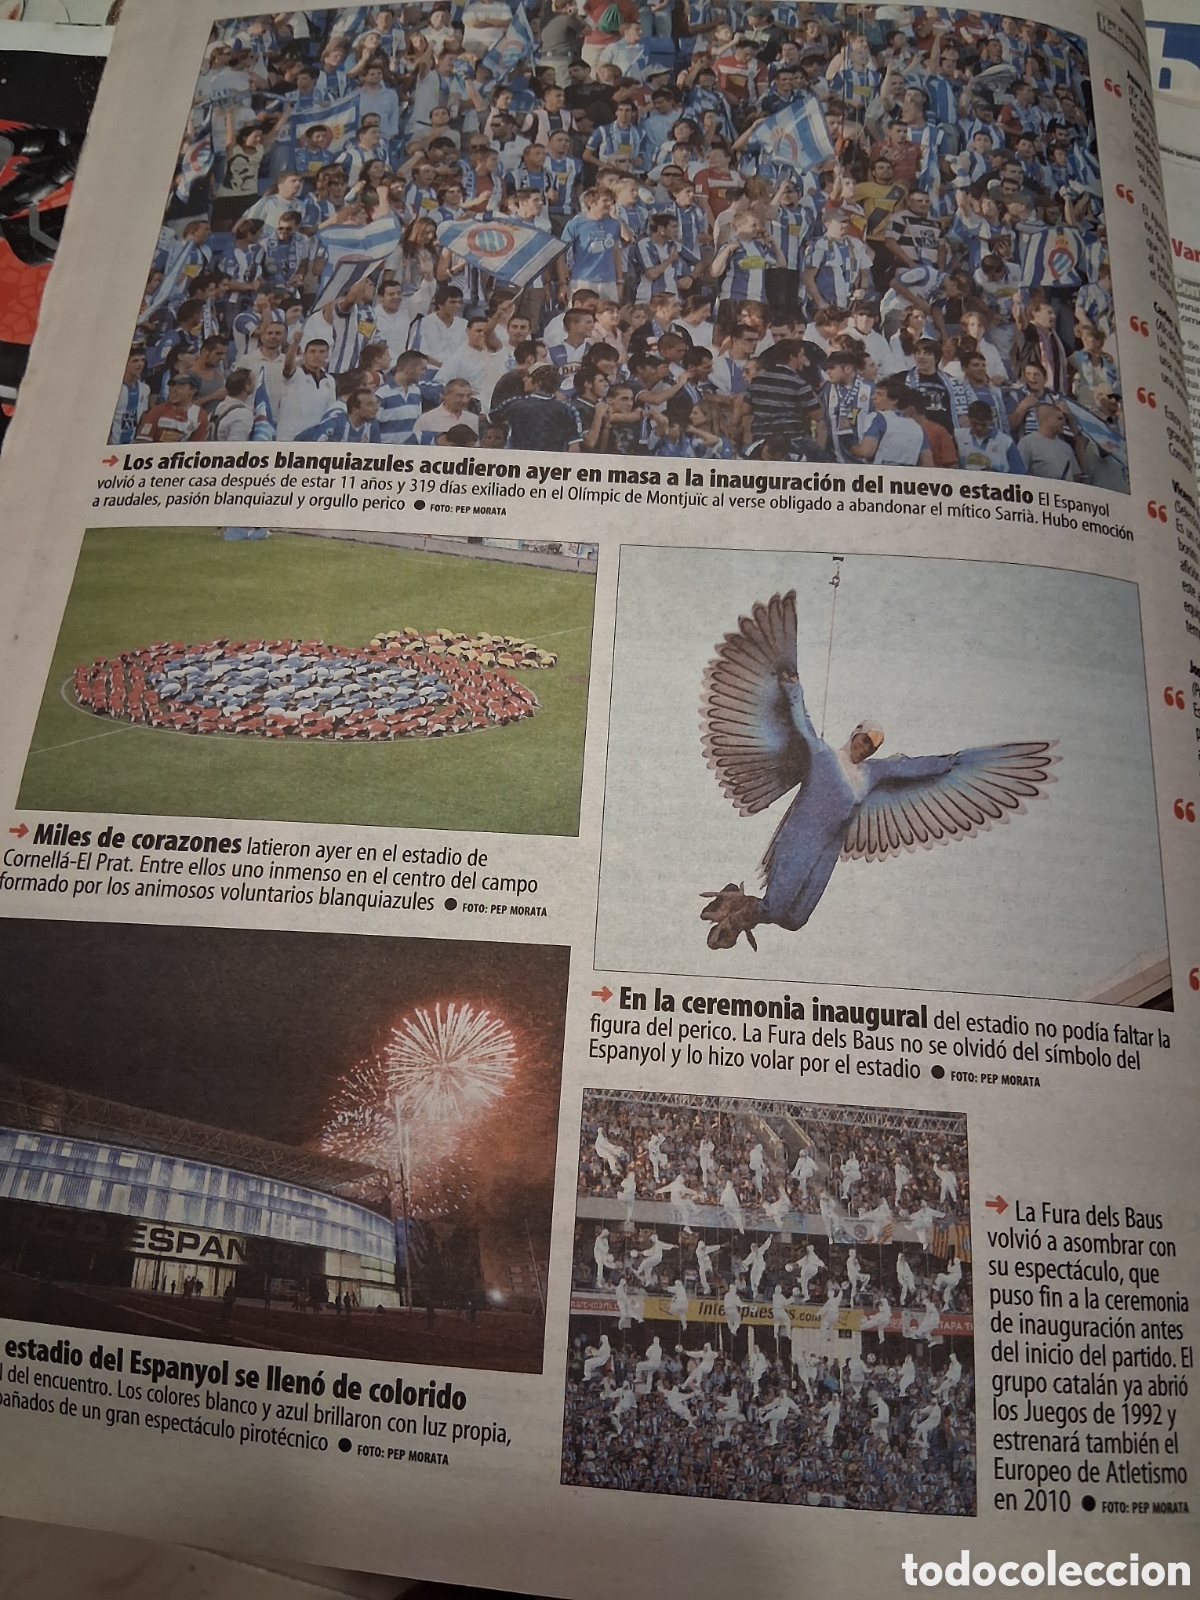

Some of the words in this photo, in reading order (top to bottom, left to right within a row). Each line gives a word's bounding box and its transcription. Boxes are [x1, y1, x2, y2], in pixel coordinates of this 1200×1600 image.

[123, 454, 153, 470] Los
[158, 451, 269, 469] aficionados
[274, 452, 414, 474] blanquiazules
[420, 457, 520, 478] acudieron
[526, 466, 572, 484] ayer
[577, 469, 601, 482] en
[608, 470, 660, 485] masa
[667, 472, 679, 486] a
[685, 468, 703, 487] la
[710, 468, 845, 494] inauguración
[852, 475, 883, 493] del
[890, 481, 953, 497] nuevo
[960, 484, 1033, 504] estadio
[1039, 492, 1049, 506] El
[1054, 494, 1109, 517] Espanyol
[98, 475, 135, 489] volvió
[138, 478, 146, 488] a
[150, 476, 185, 487] tener
[189, 477, 217, 487] casa
[221, 473, 276, 490] después
[281, 474, 297, 487] de
[302, 476, 336, 488] estar
[341, 476, 355, 489] 11
[361, 477, 393, 490] años
[397, 481, 406, 494] y
[409, 479, 435, 493] 319
[440, 480, 467, 494] días
[472, 482, 525, 497] exiliado
[530, 488, 546, 498] en
[552, 486, 563, 499] el
[568, 486, 621, 505] Olímpic
[625, 489, 642, 503] de
[647, 490, 708, 509] Montjuïc
[712, 493, 724, 507] al
[729, 497, 765, 508] verse
[770, 495, 831, 513] obligado
[837, 501, 844, 511] a
[849, 498, 926, 515] abandonar
[931, 502, 942, 516] el
[948, 503, 991, 519] mítico
[1043, 511, 1078, 529] Hubo
[1082, 521, 1133, 541] emoción
[33, 823, 92, 847] Miles
[97, 826, 125, 848] de
[132, 834, 242, 854] corazones
[247, 837, 310, 857] latieron
[316, 845, 352, 863] ayer
[357, 847, 376, 861] en
[383, 844, 397, 862] el
[402, 847, 462, 865] estadio
[467, 848, 487, 867] de
[0, 871, 68, 892] formado
[73, 880, 103, 898] por
[107, 876, 130, 895] los
[135, 879, 215, 899] animosos
[221, 882, 314, 904] voluntarios
[319, 886, 434, 912] blanquiazules
[463, 903, 488, 913] FOTO:
[490, 904, 507, 914] PEP
[510, 906, 547, 916] MORATA
[4, 849, 92, 870] Cornellá-El
[96, 853, 133, 872] Prat.
[140, 855, 183, 874] Entre
[189, 857, 226, 876] ellos
[232, 864, 264, 878] uno
[269, 861, 341, 882] inmenso
[347, 870, 367, 883] en
[373, 867, 388, 884] el
[393, 871, 445, 887] centro
[451, 870, 476, 889] del
[482, 877, 537, 897] campo
[620, 986, 646, 1010] En
[654, 988, 675, 1012] la
[682, 995, 804, 1020] ceremonia
[812, 996, 927, 1031] inaugural
[934, 1010, 960, 1031] del
[966, 1015, 1029, 1035] estadio
[1035, 1023, 1057, 1038] no
[1063, 1021, 1109, 1043] podía
[1113, 1023, 1154, 1046] faltar
[1158, 1028, 1170, 1048] la
[590, 1013, 640, 1038] figura
[647, 1017, 672, 1037] del
[679, 1020, 736, 1043] perico.
[743, 1023, 761, 1042] La
[769, 1024, 805, 1045] Fura
[812, 1027, 847, 1048] dels
[853, 1030, 894, 1051] Baus
[901, 1038, 923, 1053] no
[929, 1040, 947, 1055] se
[953, 1037, 1006, 1059] olvidó
[1013, 1041, 1039, 1061] del
[1045, 1044, 1111, 1067] símbolo
[1117, 1049, 1140, 1070] del
[1016, 1200, 1035, 1222] La
[1042, 1202, 1080, 1225] Fura
[1086, 1205, 1120, 1227] dels
[1125, 1207, 1163, 1229] Baus
[989, 1260, 1008, 1276] su
[1015, 1259, 1124, 1286] espectáculo,
[1129, 1267, 1159, 1289] que
[991, 1310, 1013, 1333] de
[1019, 1312, 1135, 1342] inauguración
[1141, 1321, 1183, 1340] antes
[5, 1339, 83, 1366] estadio
[89, 1345, 123, 1372] del
[130, 1350, 229, 1389] Espanyol
[235, 1369, 259, 1389] se
[266, 1365, 325, 1396] llenó
[333, 1372, 362, 1400] de
[369, 1378, 466, 1410] colorido
[8, 1365, 29, 1385] del
[34, 1373, 112, 1396] encuentro.
[118, 1379, 142, 1400] Los
[147, 1385, 200, 1408] colores
[206, 1390, 257, 1415] blanco
[262, 1403, 271, 1422] y
[276, 1402, 308, 1422] azul
[314, 1403, 381, 1430] brillaron
[387, 1417, 417, 1434] con
[423, 1415, 447, 1437] luz
[452, 1422, 511, 1446] propia,
[993, 1396, 1018, 1421] los
[1024, 1399, 1087, 1429] Juegos
[1093, 1401, 1115, 1424] de
[1122, 1403, 1162, 1425] 1992
[1167, 1409, 1176, 1431] y
[993, 1430, 1080, 1452] estrenará
[1085, 1431, 1159, 1454] también
[1165, 1432, 1178, 1454] el
[994, 1457, 1071, 1487] Europeo
[1078, 1459, 1100, 1483] de
[1106, 1460, 1187, 1484] Atletismo
[994, 1493, 1017, 1510] en
[1024, 1489, 1071, 1512] 2010
[1102, 1501, 1129, 1513] FOTO:
[1132, 1502, 1150, 1514] PEP
[1153, 1502, 1189, 1514] MORATA
